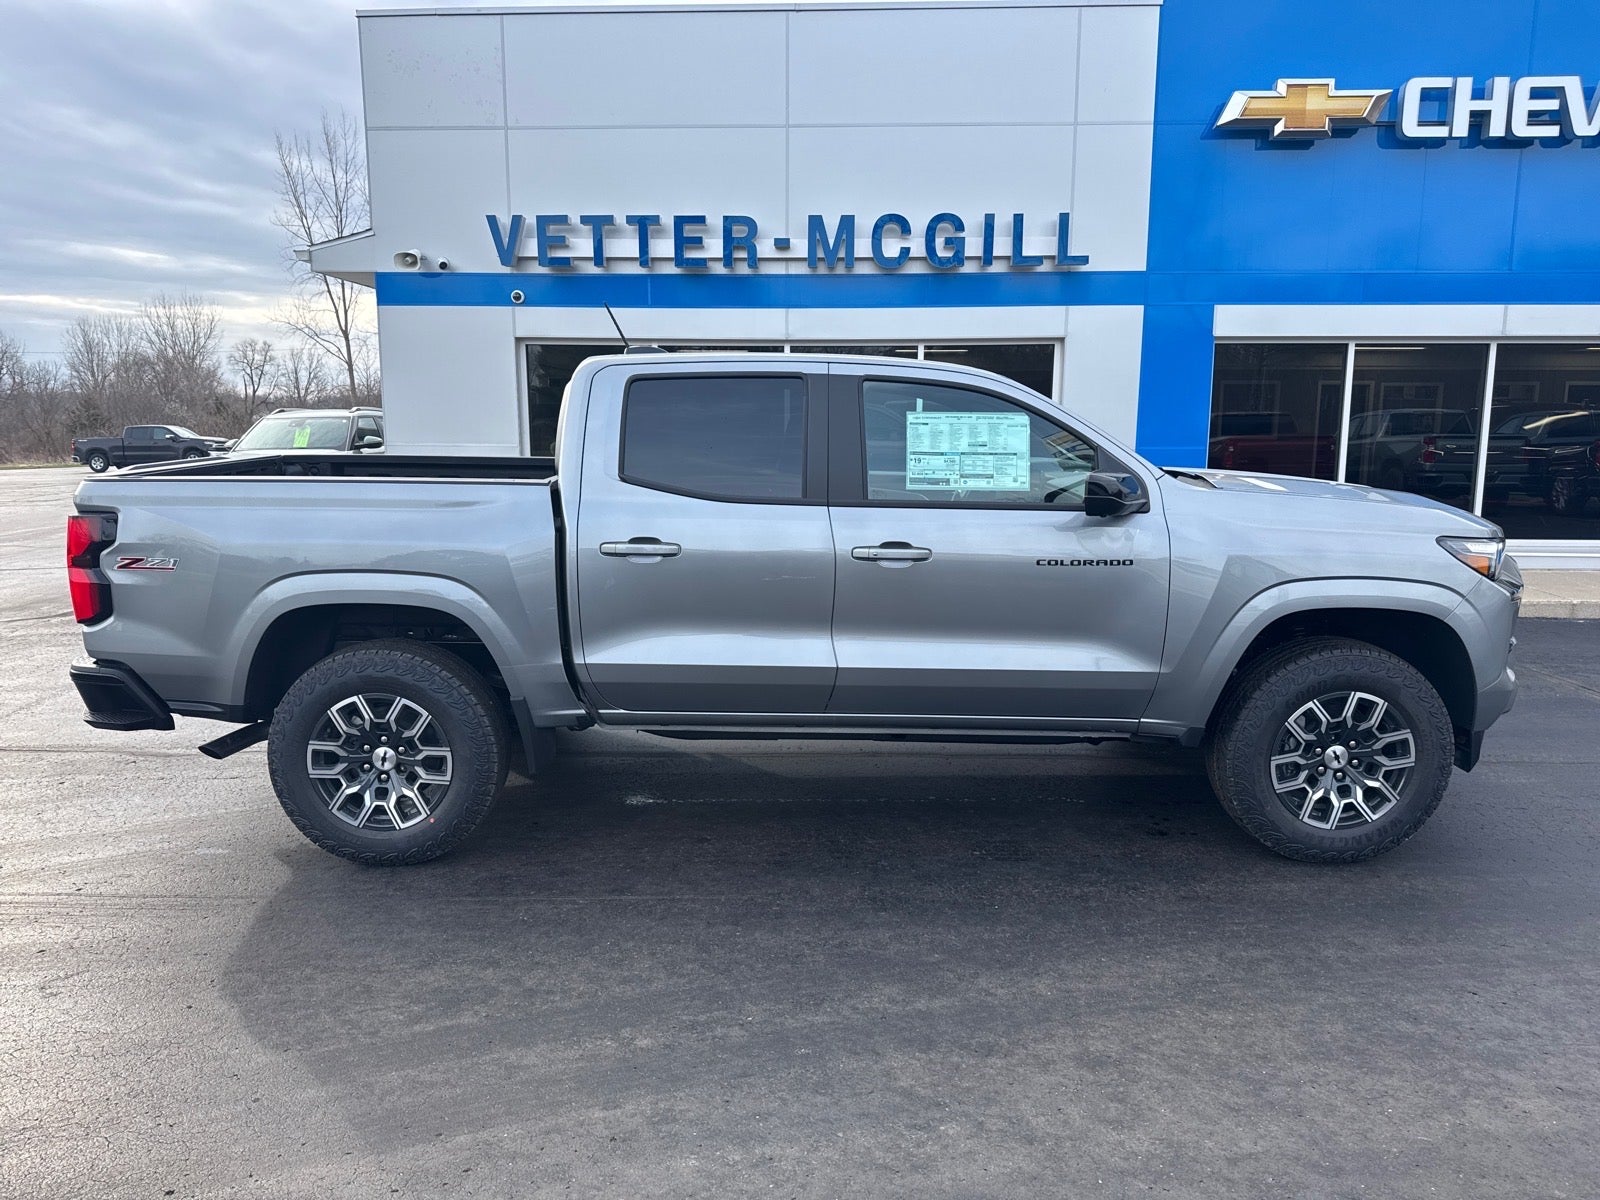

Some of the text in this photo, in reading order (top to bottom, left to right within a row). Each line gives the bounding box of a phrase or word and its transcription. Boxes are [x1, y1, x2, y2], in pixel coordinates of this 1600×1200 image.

[1398, 76, 1600, 139] CHEV
[486, 212, 1090, 270] VETTER-MCGILL
[113, 557, 179, 571] Z71
[1036, 559, 1134, 567] COLORADO
